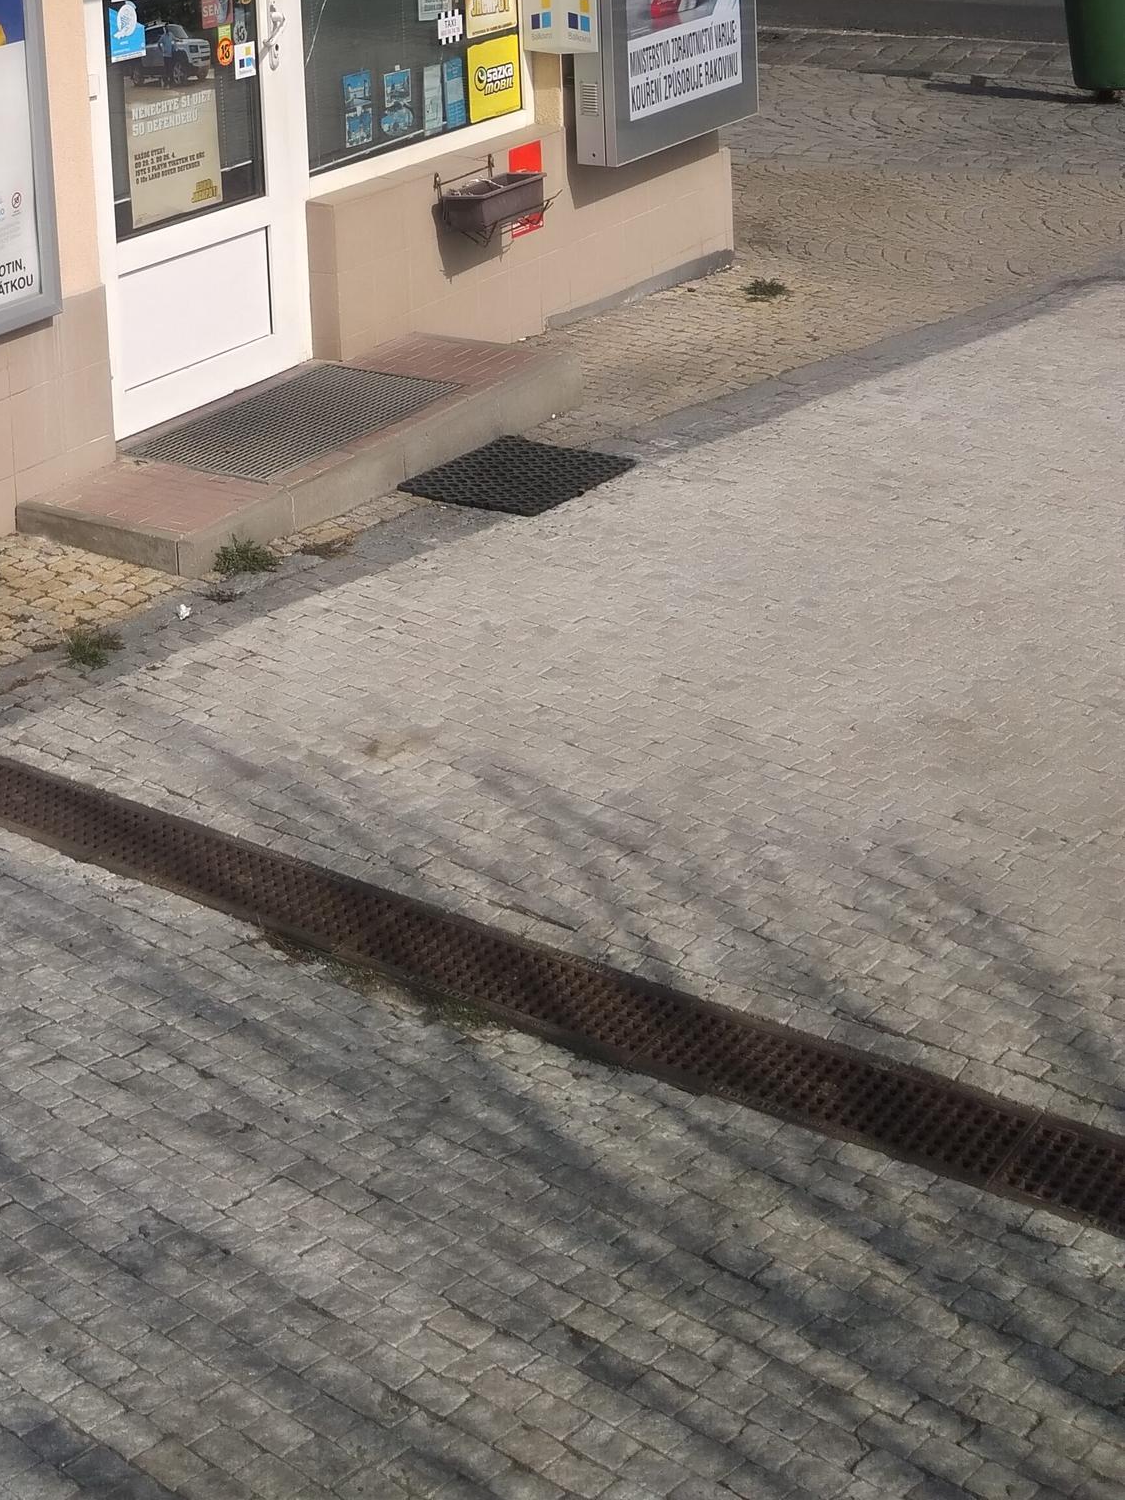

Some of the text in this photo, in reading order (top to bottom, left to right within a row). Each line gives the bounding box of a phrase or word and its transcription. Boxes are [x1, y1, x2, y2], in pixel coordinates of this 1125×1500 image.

[444, 18, 458, 29] TAXI
[629, 19, 738, 78] MINISTERSTVO ZDRAVOTNICTVÍ VARUJE:
[486, 62, 514, 82] sazka
[630, 73, 662, 113] KOUŘENÍ
[704, 51, 738, 87] RAKOVINU
[131, 97, 180, 121] NENECHTE
[132, 120, 146, 137] 50
